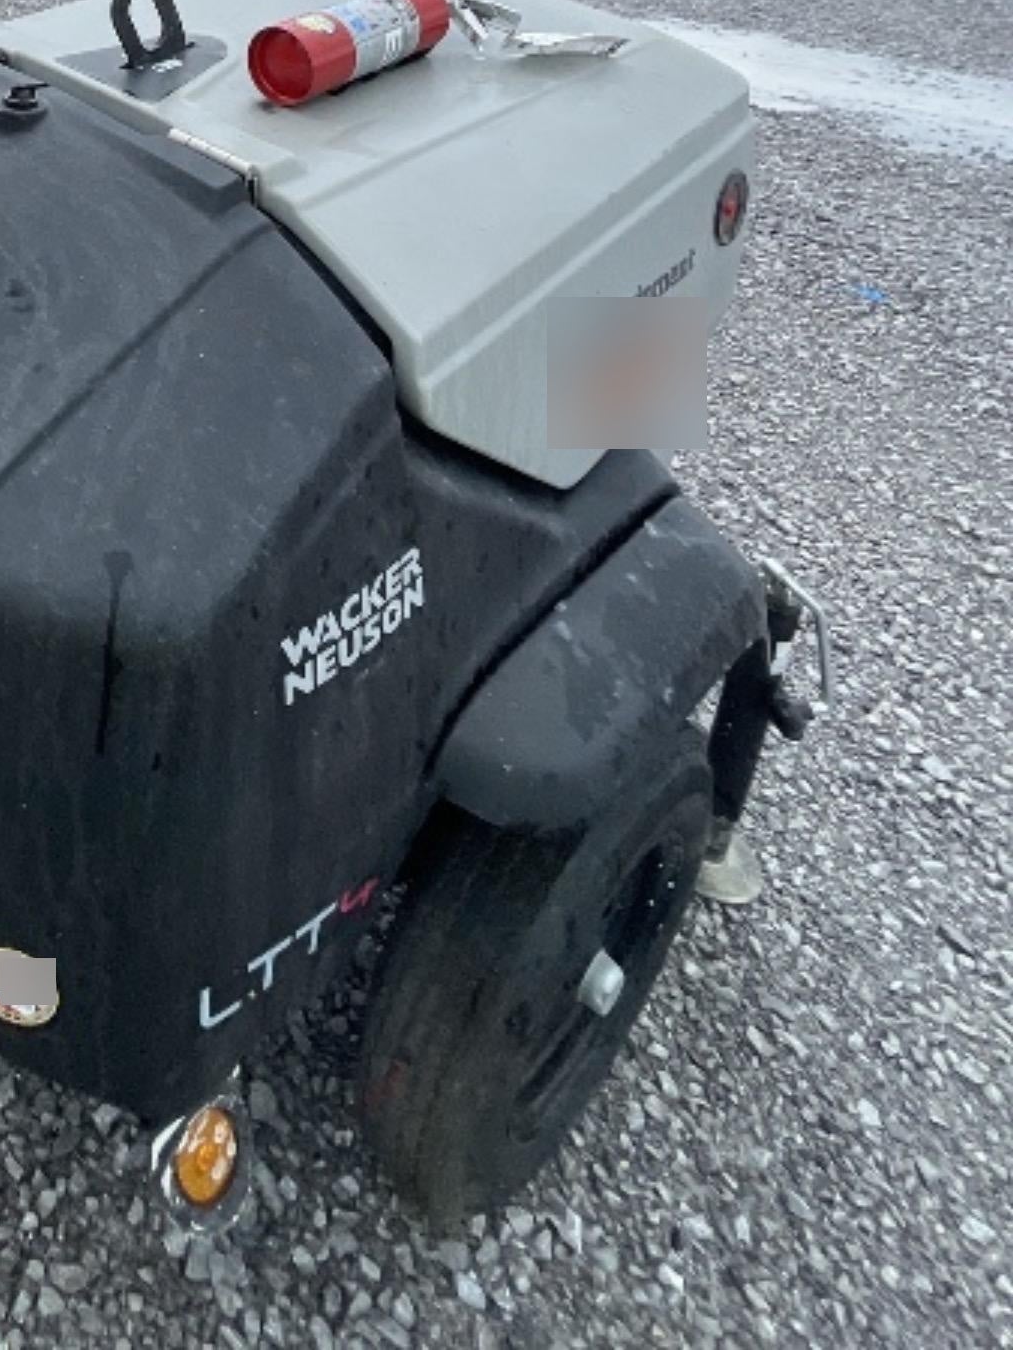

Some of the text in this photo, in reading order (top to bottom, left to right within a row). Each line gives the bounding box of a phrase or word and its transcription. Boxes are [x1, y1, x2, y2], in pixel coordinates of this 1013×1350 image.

[280, 547, 423, 667] WACKER
[284, 575, 425, 706] NEUSON
[199, 875, 381, 1030] LTT4
